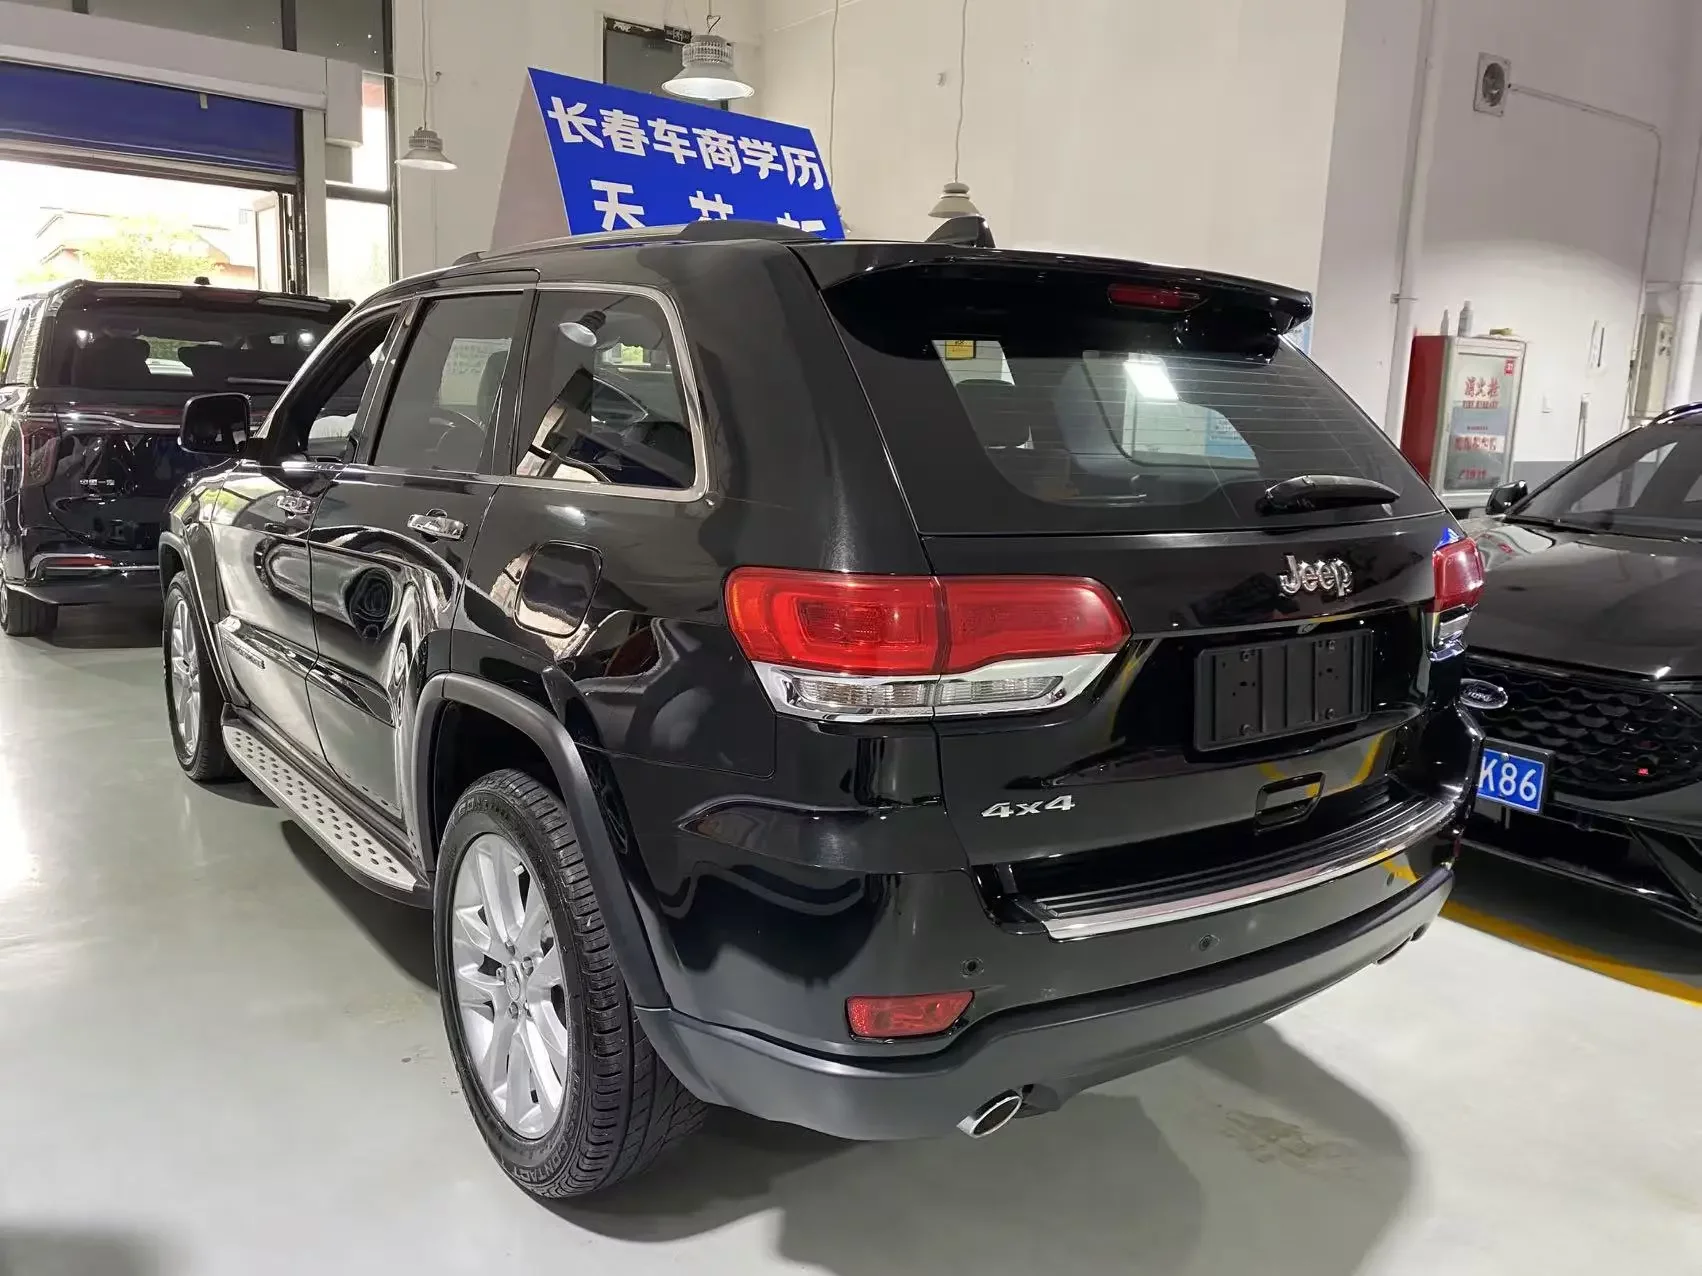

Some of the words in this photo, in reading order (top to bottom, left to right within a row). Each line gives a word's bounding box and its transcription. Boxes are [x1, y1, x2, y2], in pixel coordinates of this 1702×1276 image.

[547, 96, 824, 190] 长春车商学历
[1279, 555, 1352, 597] Jeep
[1478, 756, 1537, 802] K86
